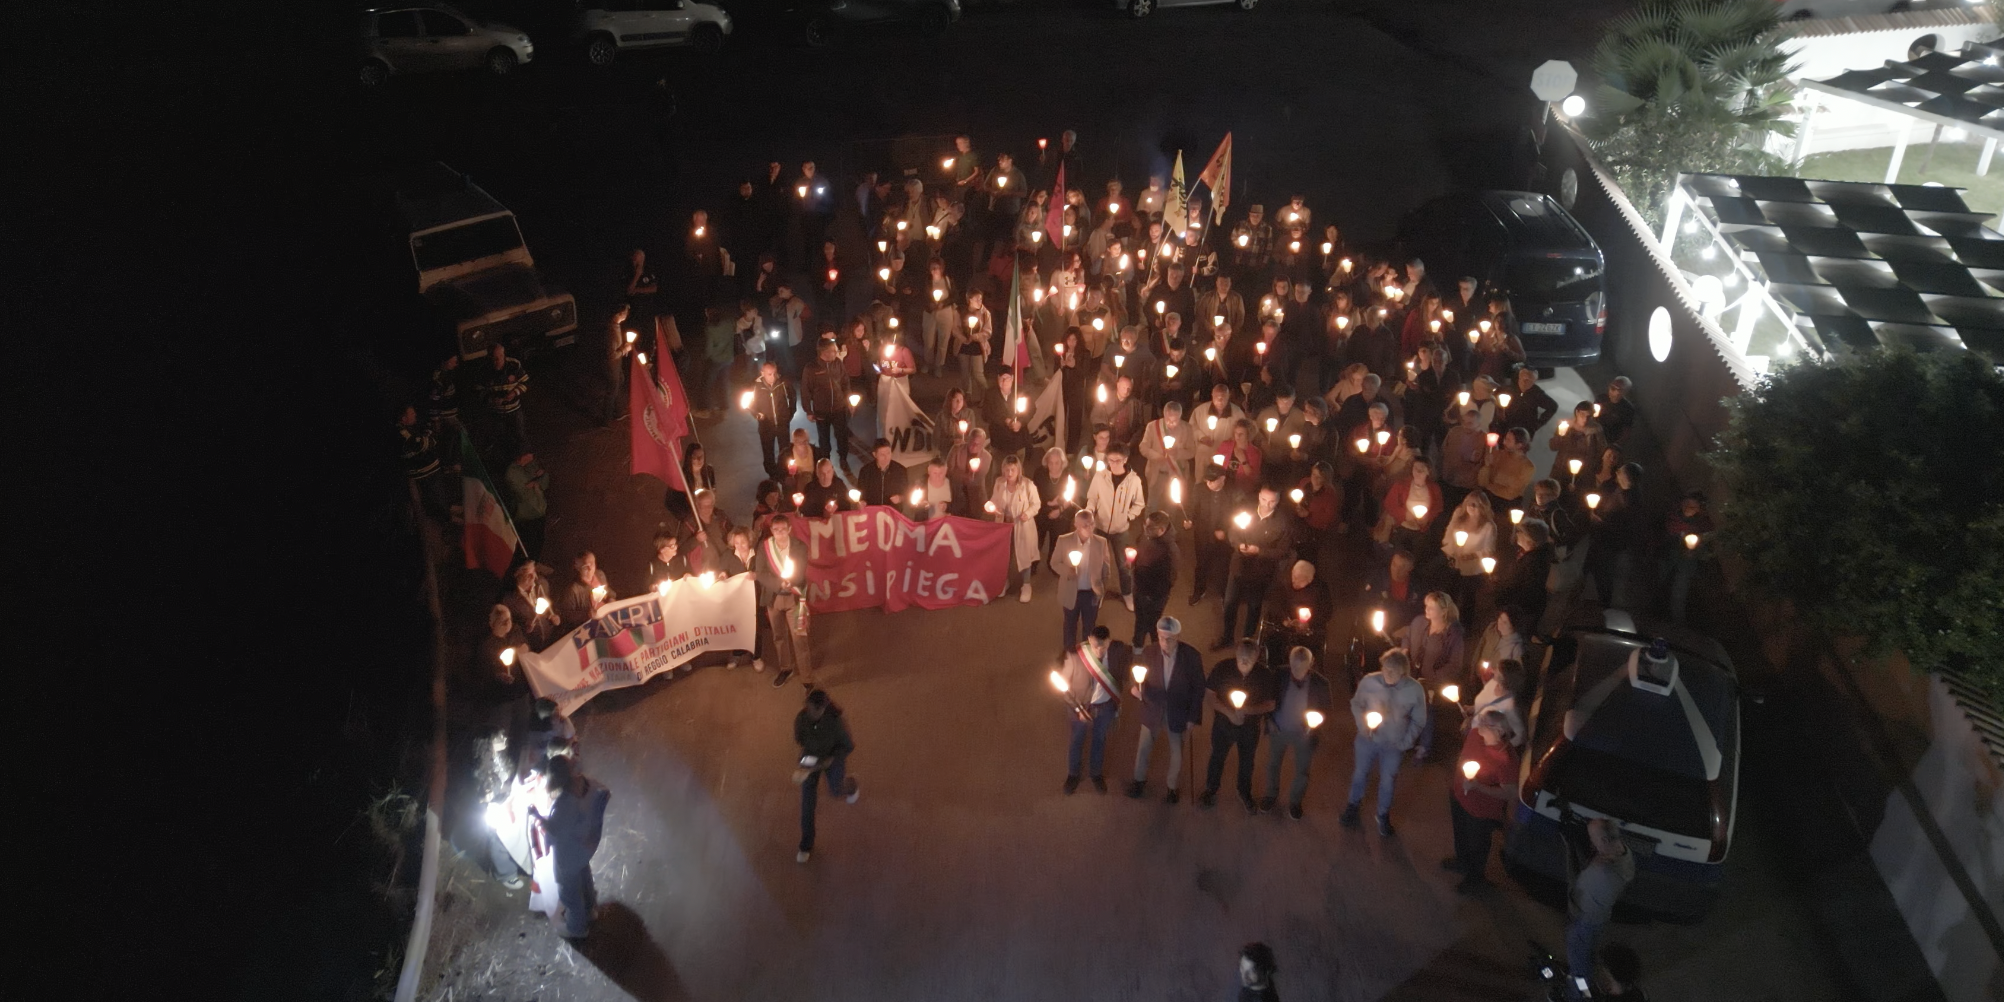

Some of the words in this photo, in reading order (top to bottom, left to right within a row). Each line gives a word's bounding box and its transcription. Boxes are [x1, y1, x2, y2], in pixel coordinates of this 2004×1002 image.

[1536, 72, 1572, 88] STOP
[589, 657, 640, 681] NAZIONALE
[640, 631, 689, 663] PARTIGIANI
[694, 625, 737, 637] D'ITALIA
[644, 655, 668, 676] REGGIO
[671, 638, 710, 659] CALABRIA
